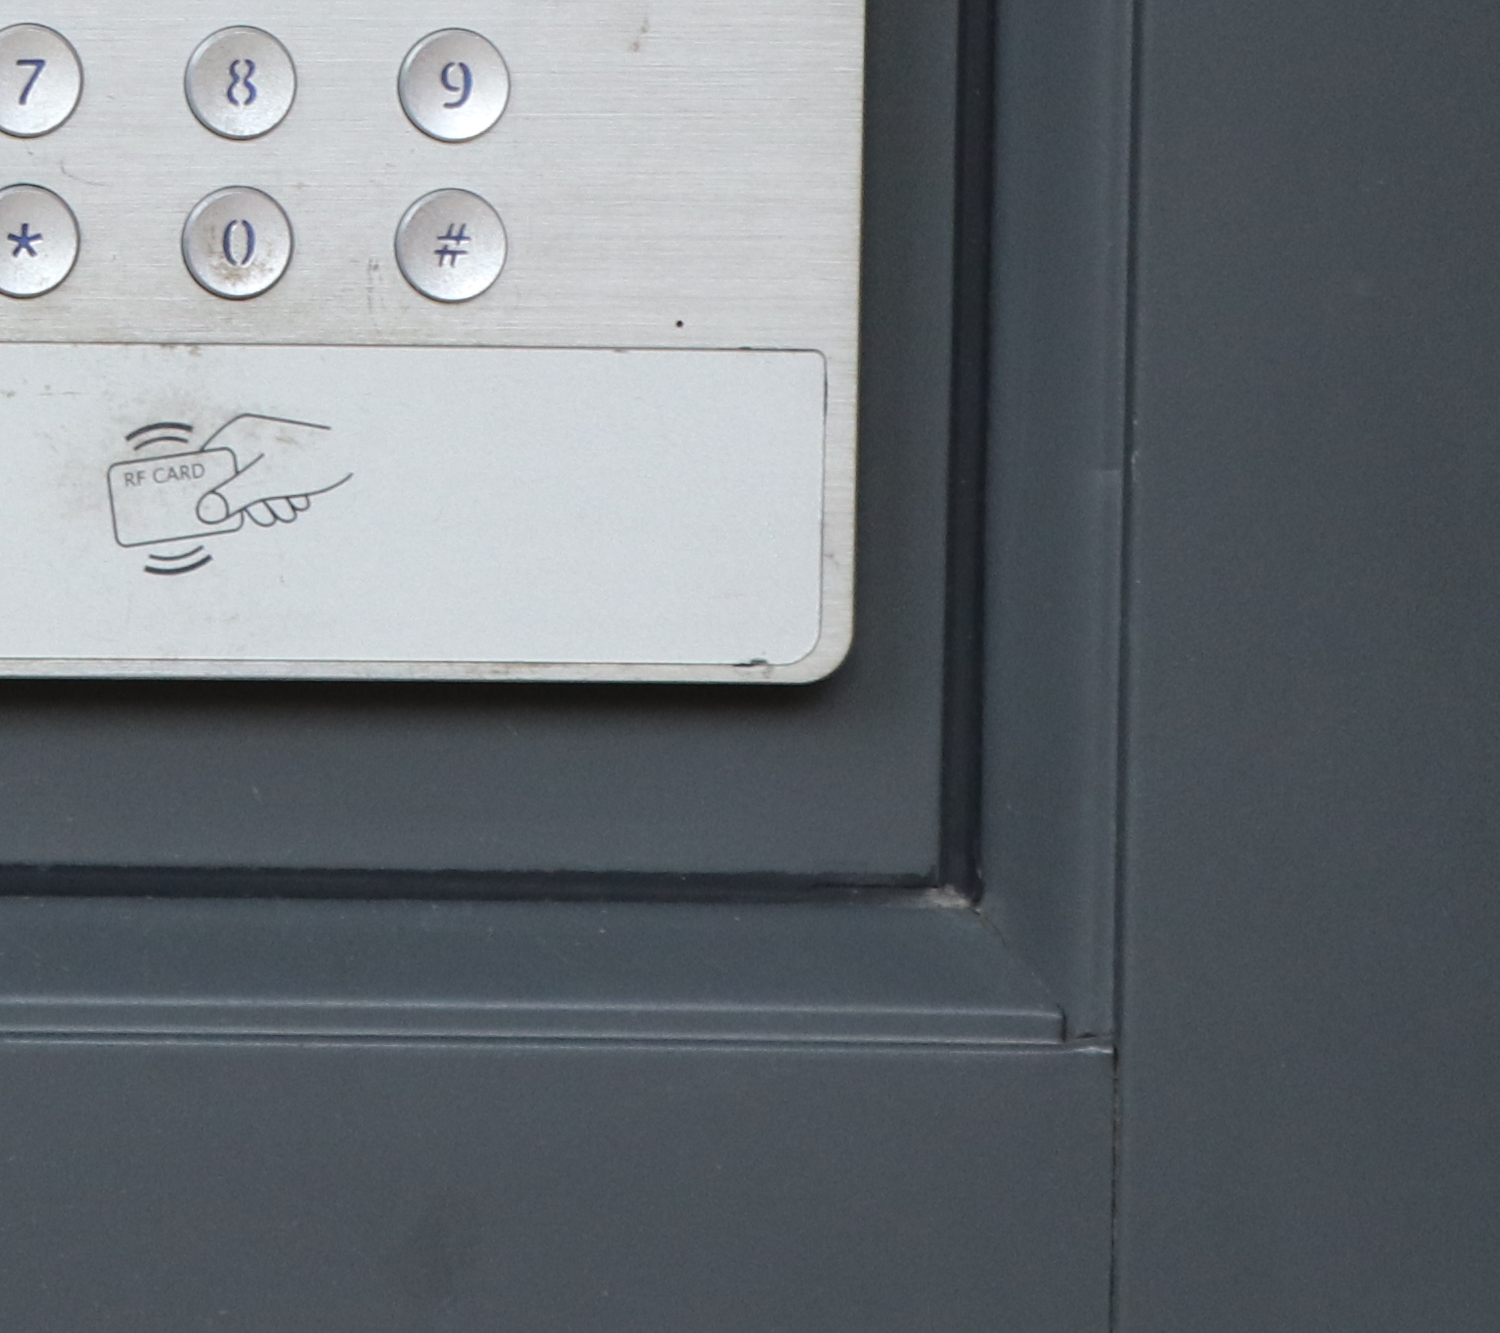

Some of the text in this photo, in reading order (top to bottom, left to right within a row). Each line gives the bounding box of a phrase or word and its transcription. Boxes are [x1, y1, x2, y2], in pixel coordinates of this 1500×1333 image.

[15, 58, 473, 109] 7 8 9
[222, 218, 256, 267] 0
[124, 462, 206, 488] RF CARD
